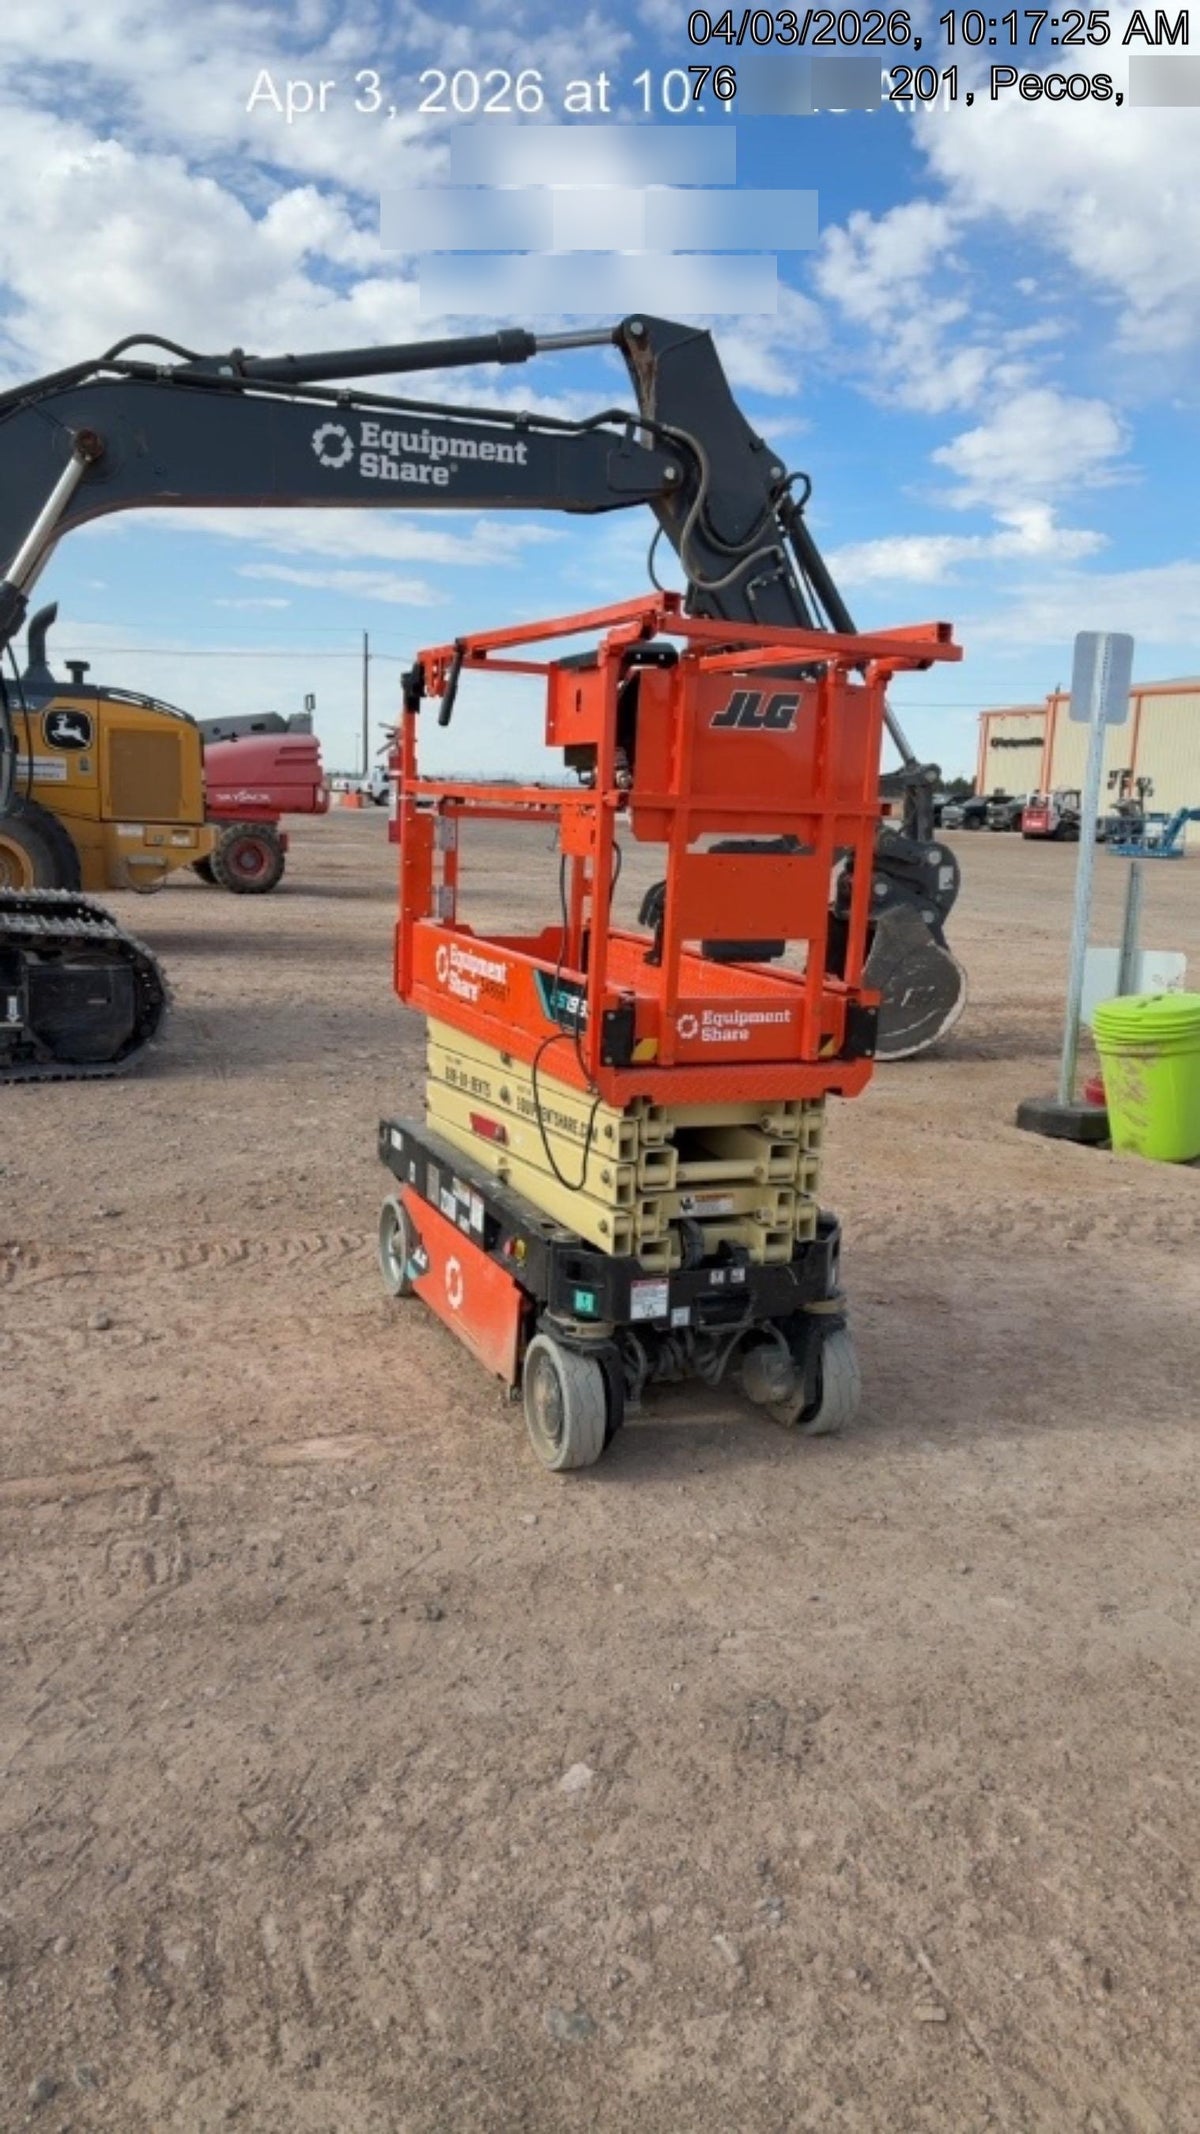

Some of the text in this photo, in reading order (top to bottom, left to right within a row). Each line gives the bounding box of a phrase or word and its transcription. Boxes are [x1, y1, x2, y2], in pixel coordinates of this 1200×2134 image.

[359, 420, 528, 466] Equipment
[708, 689, 802, 732] JLG
[448, 942, 507, 986] Equipment
[447, 969, 480, 1003] Share
[701, 1009, 792, 1028] Equipment
[701, 1026, 751, 1042] Share
